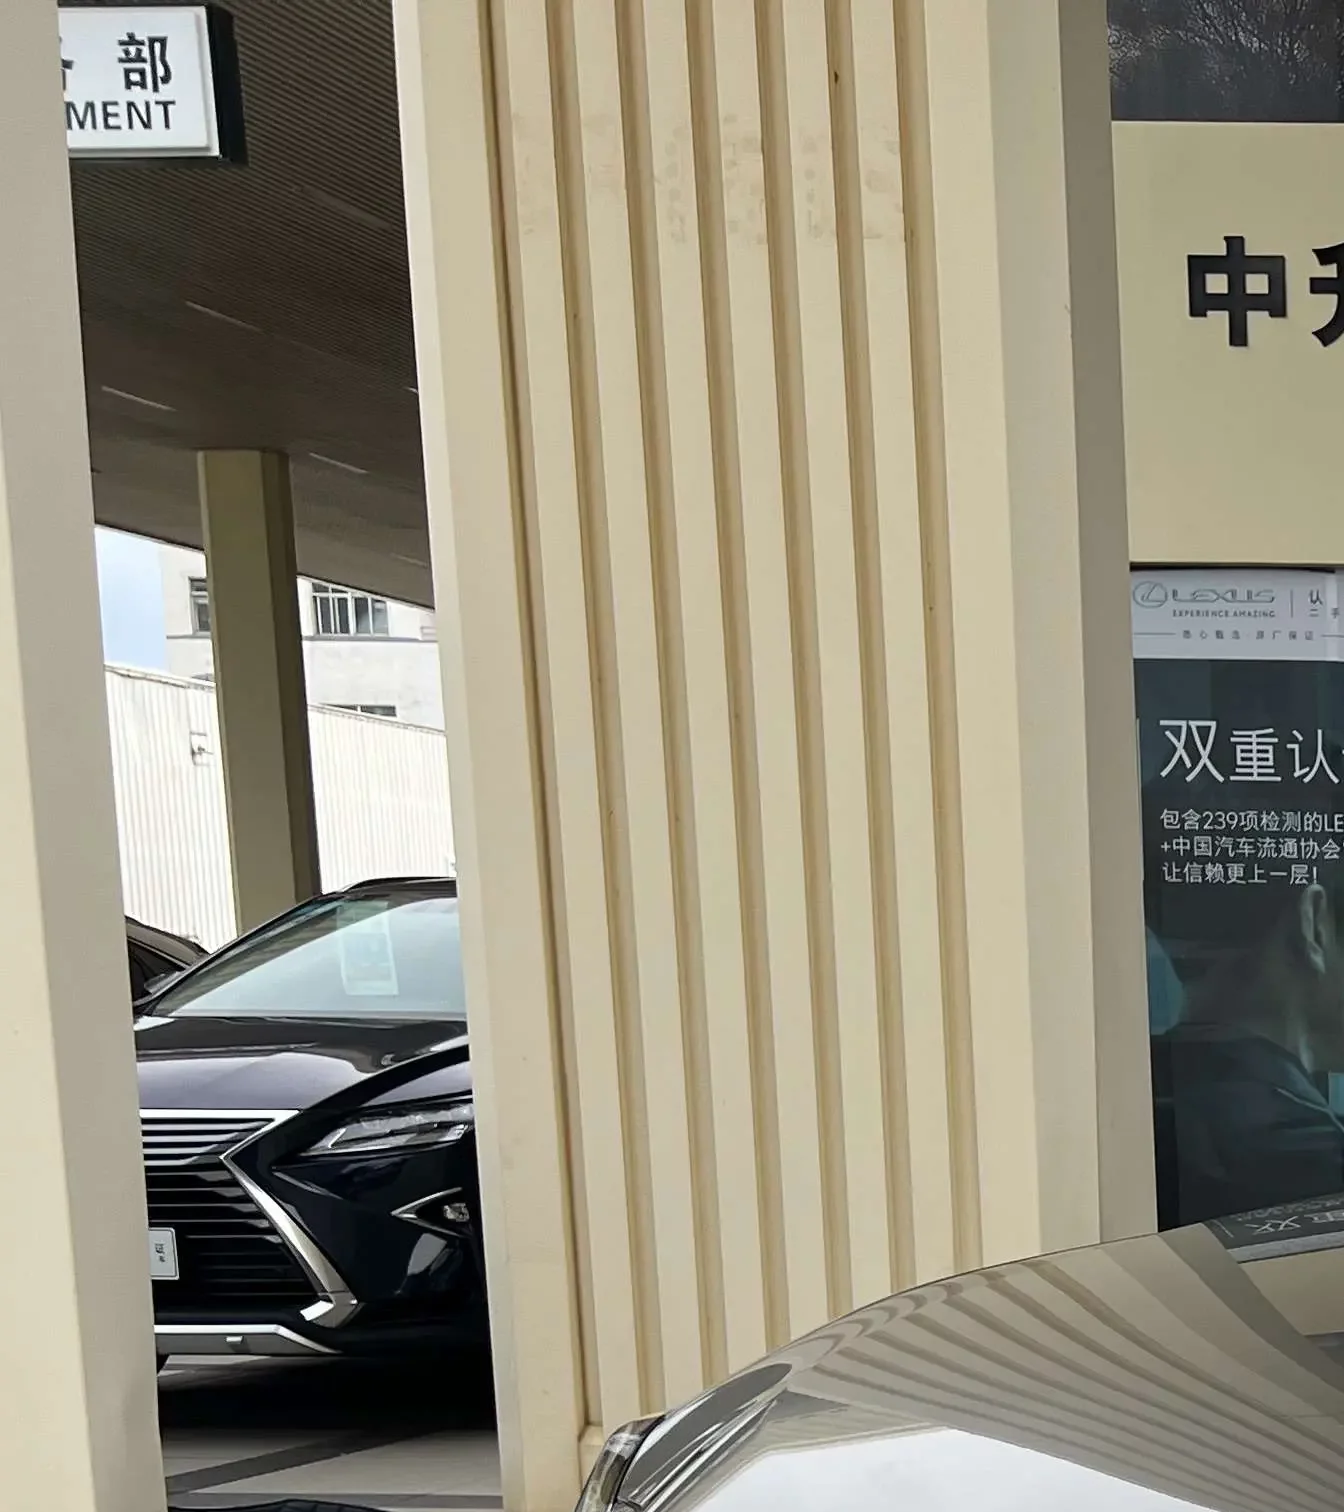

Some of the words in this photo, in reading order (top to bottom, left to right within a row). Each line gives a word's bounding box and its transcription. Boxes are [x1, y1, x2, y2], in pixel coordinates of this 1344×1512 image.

[1172, 588, 1276, 604] LEXUS
[1172, 609, 1229, 618] EXPERIENCE
[1232, 609, 1276, 618] AMAZING
